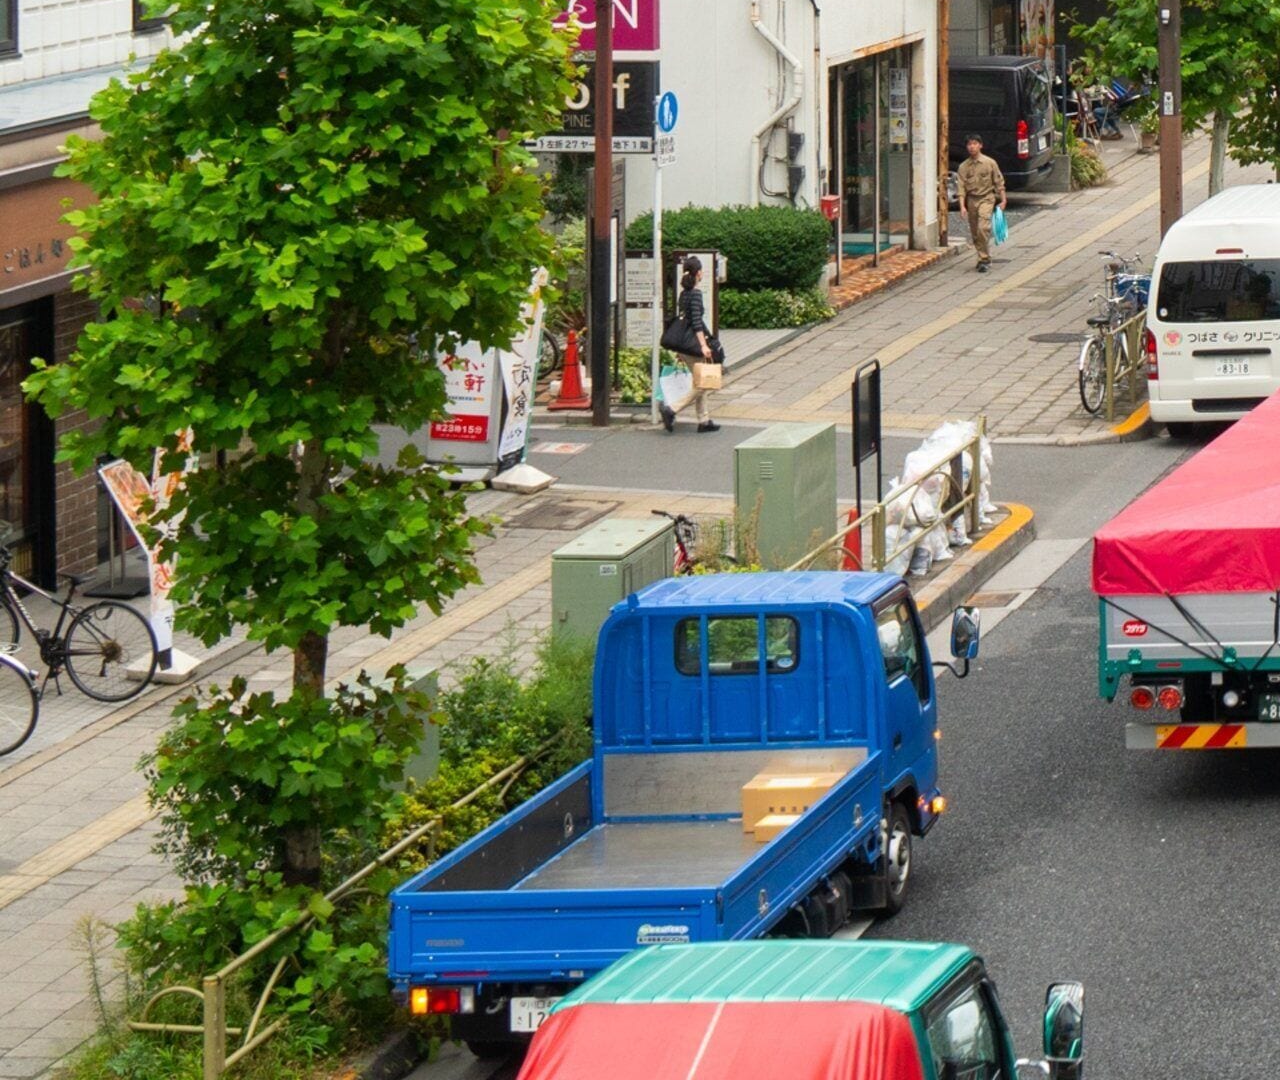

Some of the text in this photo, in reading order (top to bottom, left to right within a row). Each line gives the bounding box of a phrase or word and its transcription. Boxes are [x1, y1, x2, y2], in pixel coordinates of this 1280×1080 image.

[613, 139, 649, 150] 地下1階
[1188, 332, 1218, 342] つばさ
[464, 374, 485, 392] 軒
